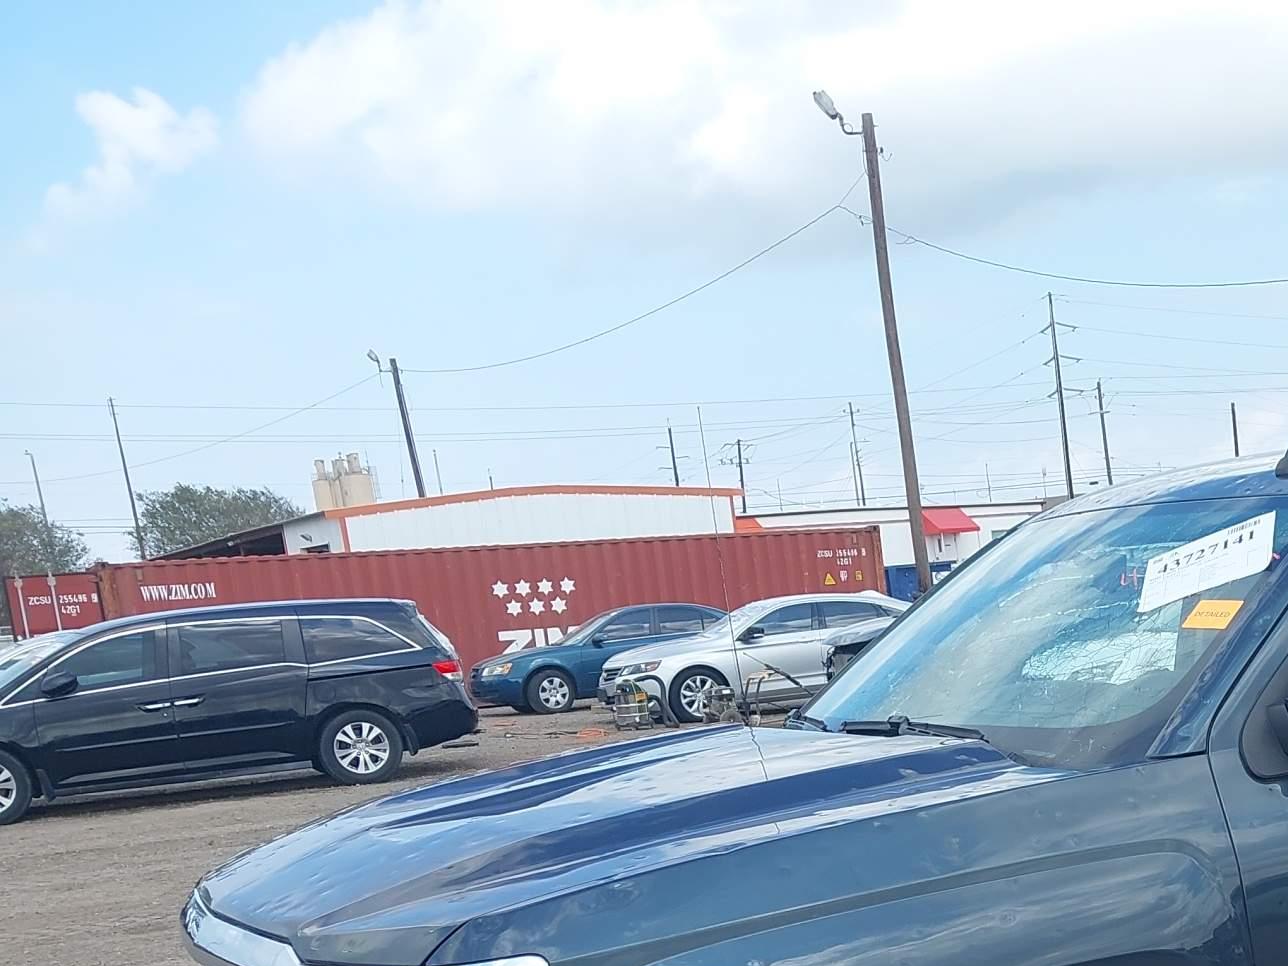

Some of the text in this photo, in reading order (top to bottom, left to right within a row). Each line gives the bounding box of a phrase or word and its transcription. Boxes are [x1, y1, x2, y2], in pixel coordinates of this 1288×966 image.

[1157, 530, 1254, 573] 43727141
[140, 582, 217, 602] WWW.ZIM.COM
[28, 596, 52, 606] ZCSU
[1193, 610, 1232, 619] DETAILED
